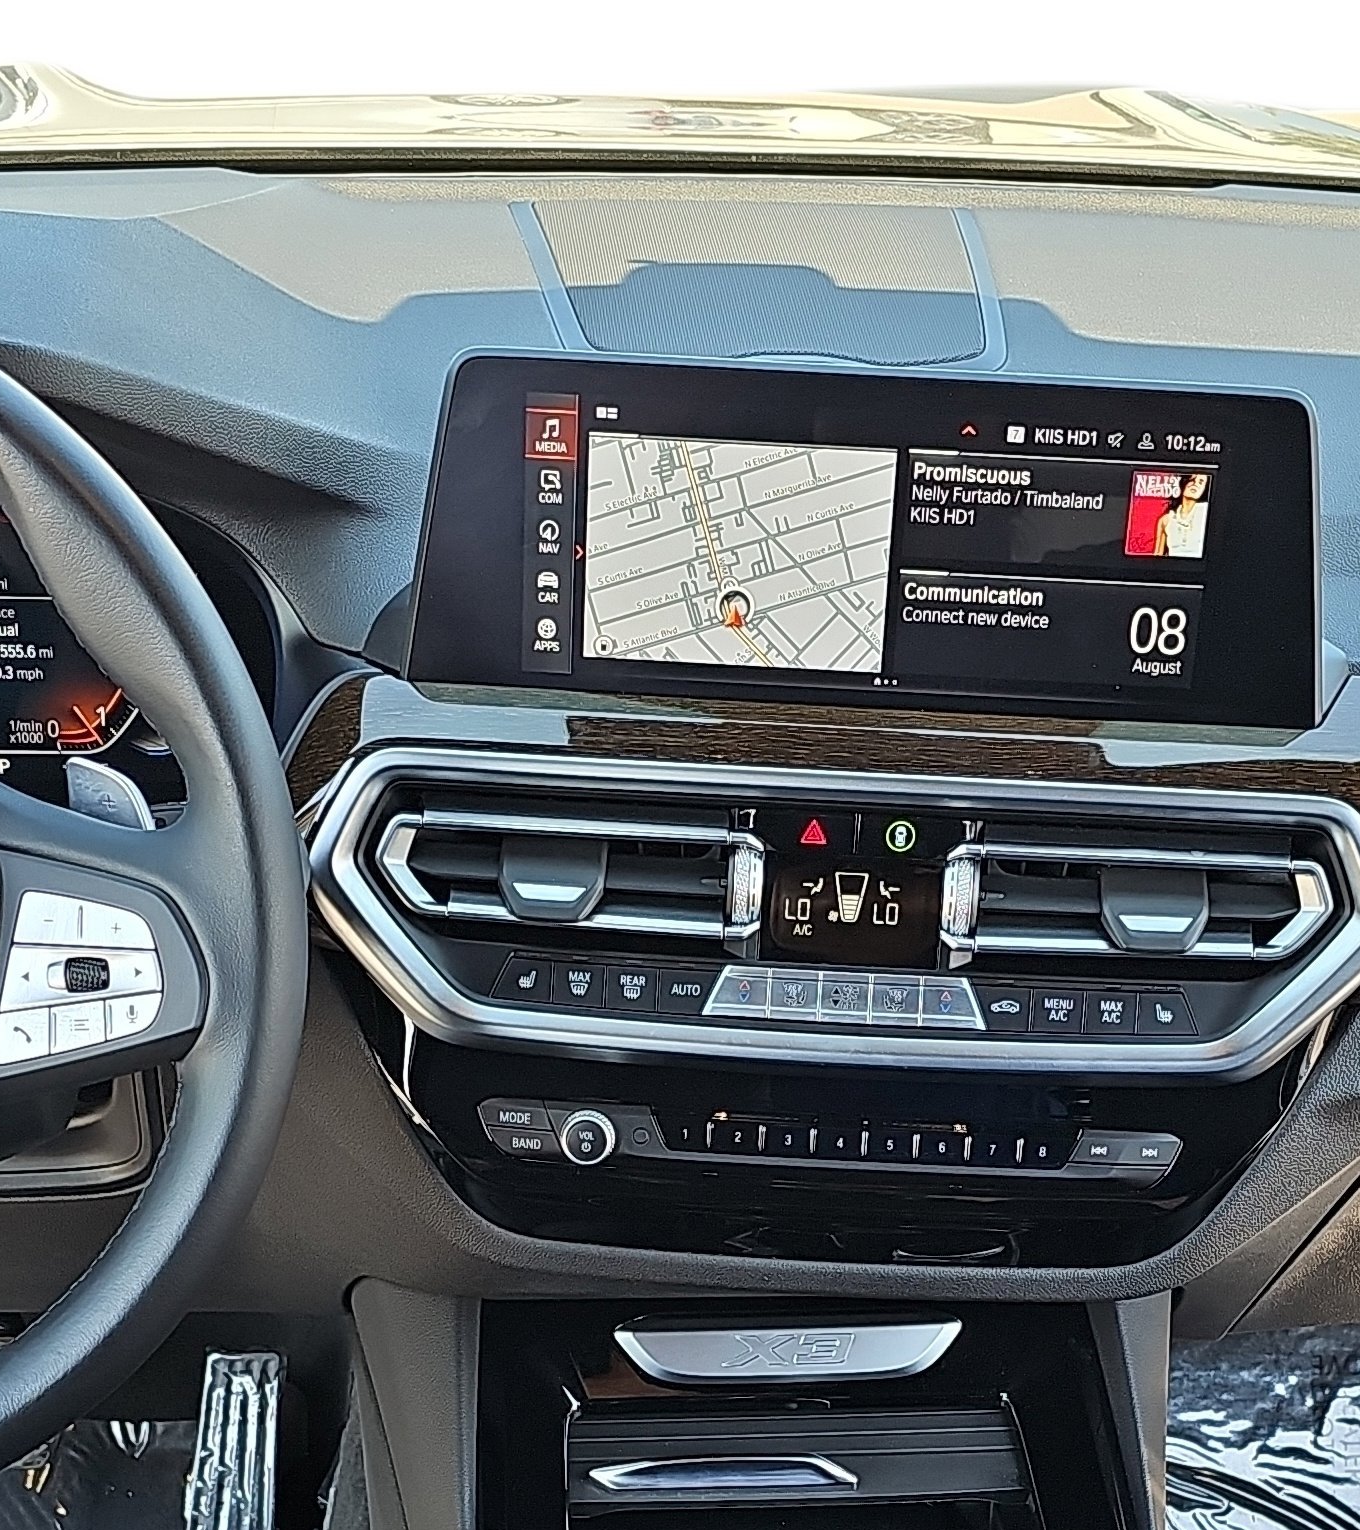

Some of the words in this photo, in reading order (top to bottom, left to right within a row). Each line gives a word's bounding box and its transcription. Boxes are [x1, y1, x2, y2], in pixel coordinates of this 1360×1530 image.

[1034, 428, 1065, 445] KIIS
[1067, 430, 1097, 446] HD1
[1165, 434, 1221, 452] 10:12am
[535, 441, 567, 454] MEDIA
[913, 462, 1031, 486] Promiscuous
[538, 493, 563, 504] COM
[911, 484, 949, 504] Nelly
[953, 487, 1011, 506] Furtado
[1014, 491, 1020, 506] /
[1024, 491, 1104, 510] Timbaland
[909, 507, 940, 524] KIIS
[943, 509, 976, 526] HD1
[538, 543, 560, 554] NAV
[537, 592, 559, 603] CAR
[904, 582, 1043, 606] Communication
[902, 607, 965, 624] Connect
[968, 611, 998, 626] new
[1001, 610, 1049, 629] device
[1130, 606, 1187, 656] 08
[39, 646, 53, 659] mi
[534, 641, 560, 652] APPS
[1132, 658, 1181, 676] August
[16, 668, 44, 682] mph
[95, 706, 106, 727] 1
[9, 720, 43, 732] 1/min
[47, 720, 59, 738] 0
[9, 732, 44, 744] x1000
[785, 899, 810, 921] LO
[873, 902, 899, 925] LO
[792, 924, 813, 937] A/C
[568, 970, 592, 984] MAX
[619, 974, 646, 986] REAR
[670, 983, 701, 996] AUTO
[1044, 998, 1074, 1010] MENU
[1100, 1000, 1123, 1013] MAX
[1049, 1010, 1068, 1022] A/C
[1102, 1012, 1121, 1024] A/C
[499, 1111, 531, 1126] MODE
[578, 1130, 595, 1141] VOL
[682, 1129, 688, 1140] 1
[734, 1132, 742, 1143] 2
[784, 1134, 792, 1146] 3
[512, 1137, 541, 1150] BAND
[835, 1137, 844, 1148] 4
[886, 1139, 894, 1151] 5
[939, 1142, 946, 1153] 6
[989, 1144, 996, 1156] 7
[1039, 1147, 1046, 1158] 8
[721, 1332, 856, 1368] X3
